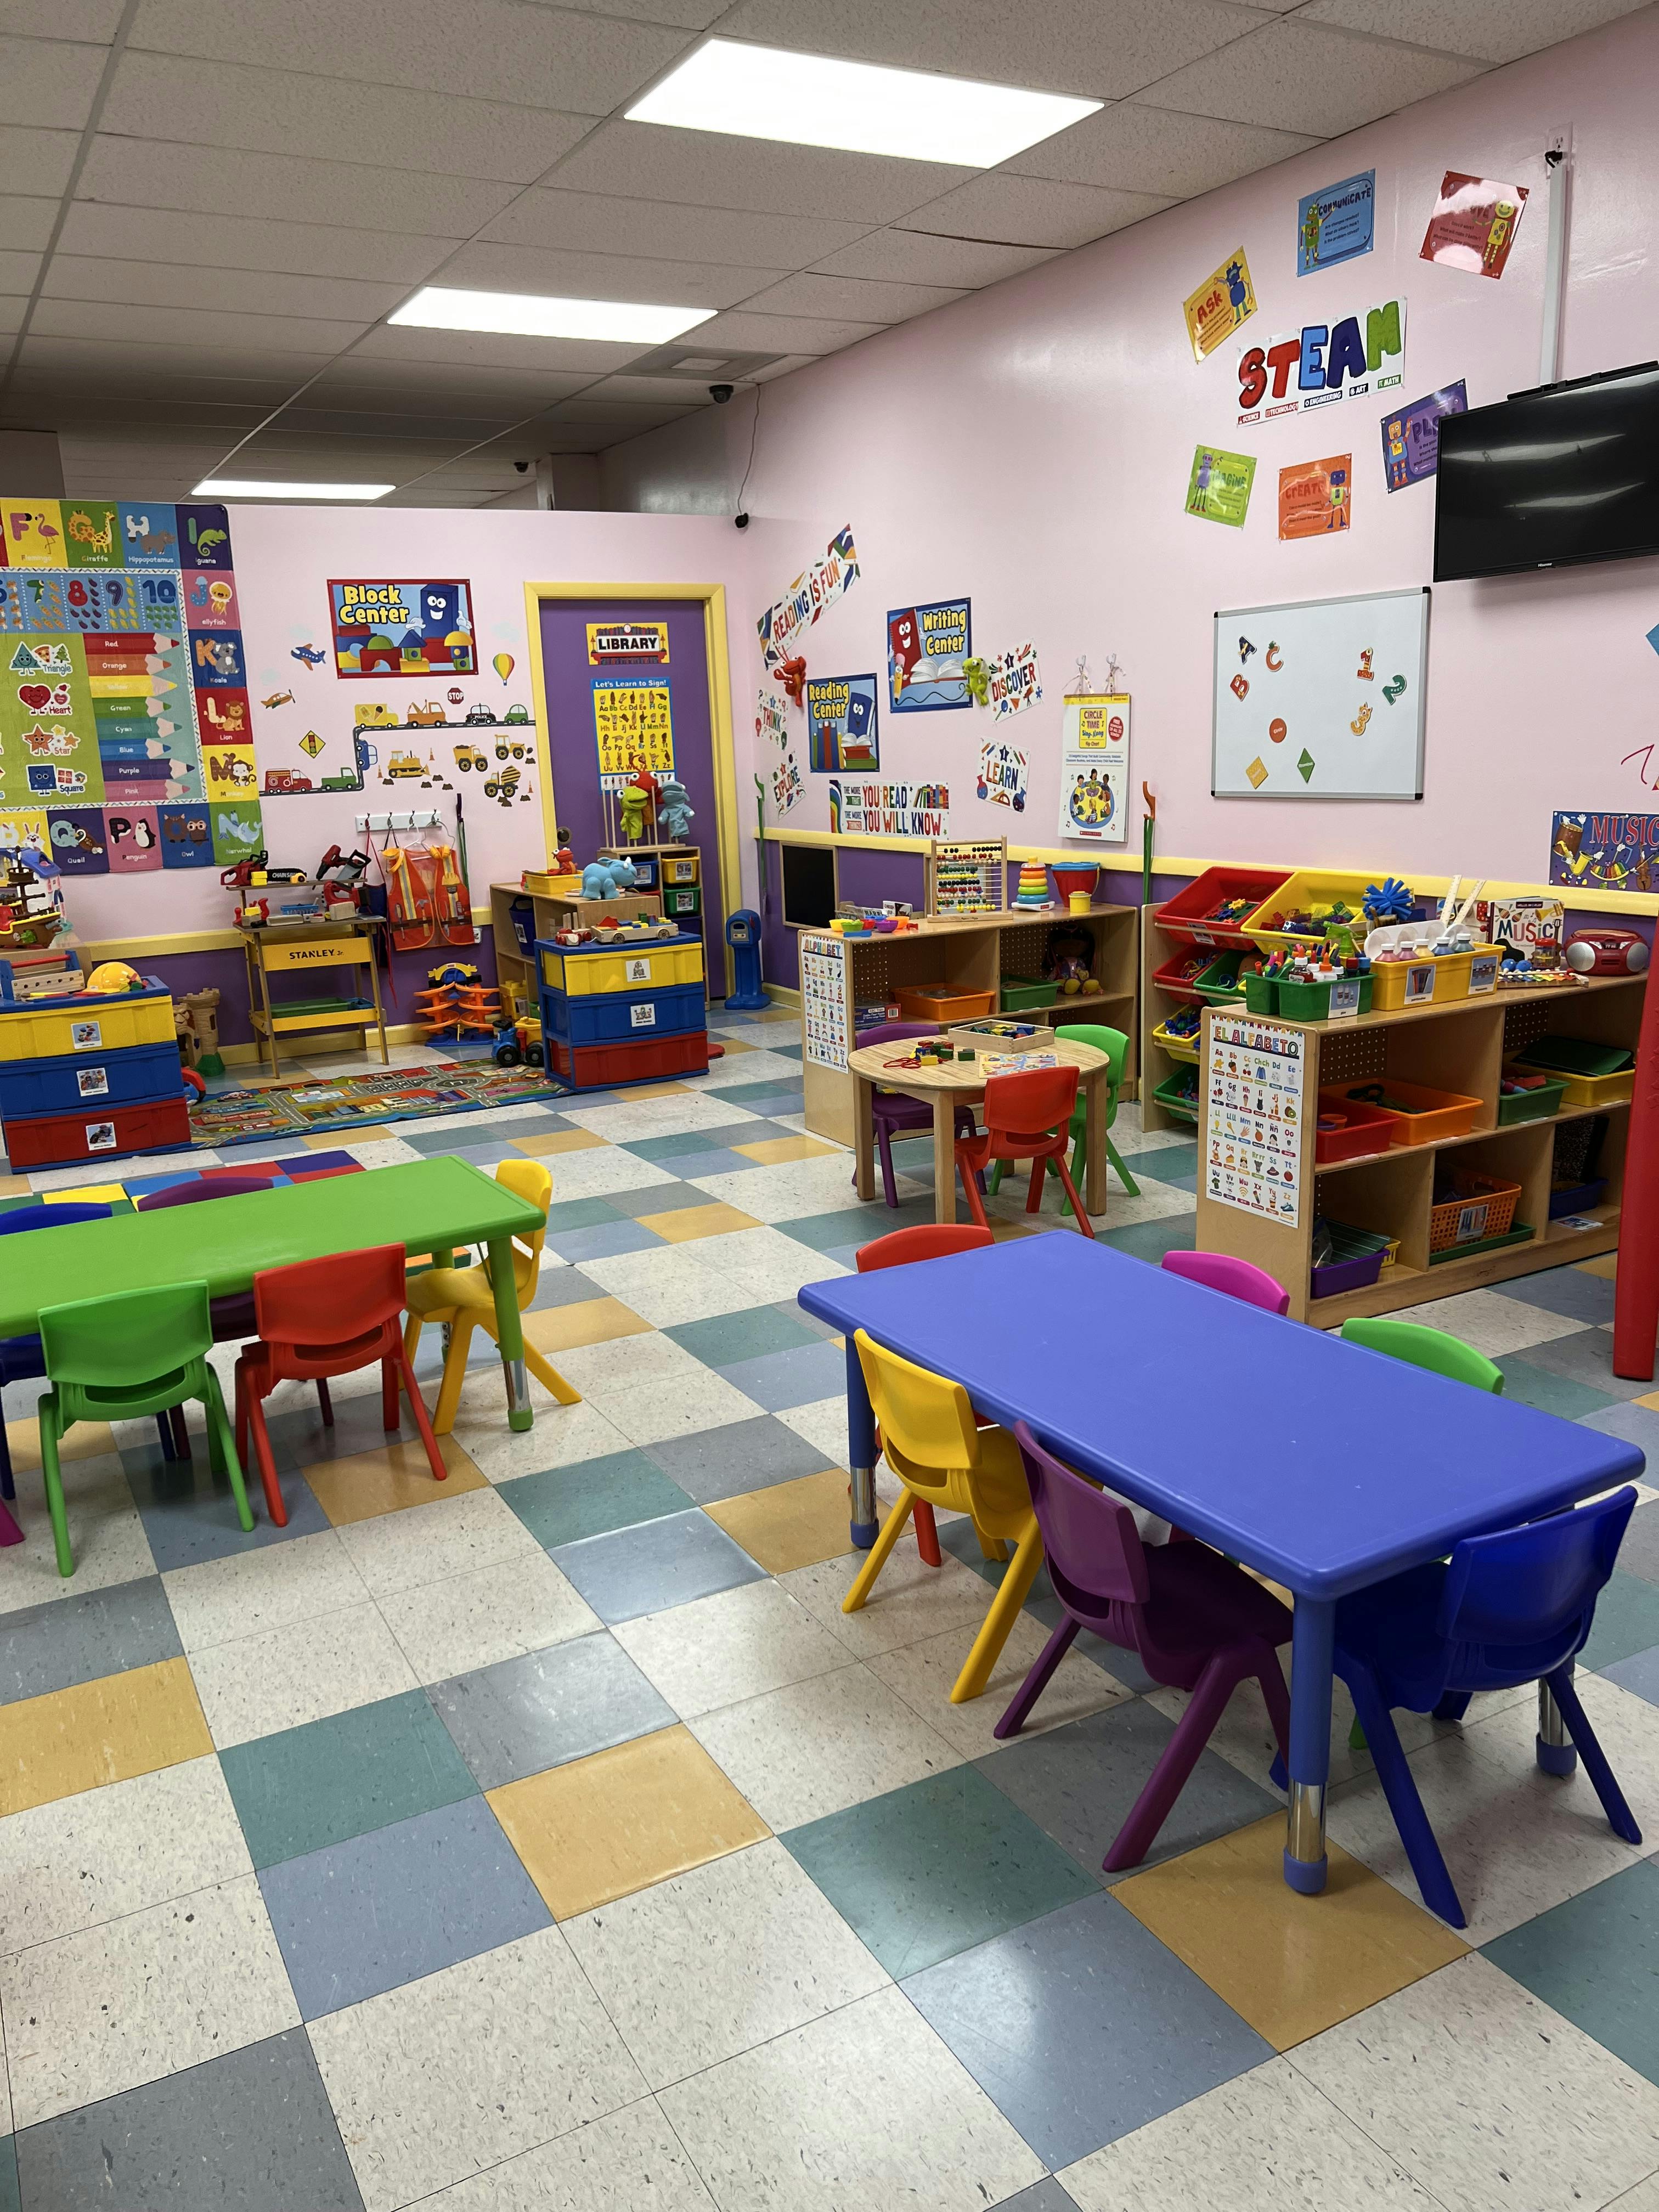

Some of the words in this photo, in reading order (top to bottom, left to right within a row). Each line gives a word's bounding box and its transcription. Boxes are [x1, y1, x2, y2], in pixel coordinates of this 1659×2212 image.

[1239, 301, 1402, 409] STEAM
[1269, 402, 1299, 416] TECHNOLOGY
[1309, 391, 1342, 405] ENGINEERING
[1356, 385, 1367, 394] ART
[1384, 375, 1400, 386] MATH
[10, 512, 32, 541] F
[68, 510, 97, 543] G
[82, 554, 109, 562] Giraffe
[128, 556, 174, 565] Hippopotamus
[195, 557, 217, 566] Iguana
[27, 579, 44, 604] 7
[67, 580, 88, 607] 8
[106, 580, 123, 607] 9
[142, 579, 177, 604] 10
[343, 584, 403, 606] Block
[773, 589, 810, 644] READING
[809, 578, 821, 606] IS
[820, 556, 840, 595] FUN
[338, 605, 411, 625] Center
[922, 608, 967, 633] Writing
[195, 638, 218, 667] K
[598, 637, 658, 651] LIBRARY
[925, 634, 965, 656] Center
[1238, 636, 1256, 664] A
[102, 662, 127, 670] Orange
[1266, 645, 1283, 672] C
[42, 664, 72, 676] Triangle
[808, 680, 850, 705] Reading
[991, 662, 1037, 702] DISCOVER
[1230, 674, 1249, 702] B
[448, 692, 465, 701] STOP
[658, 703, 667, 712] Gg
[49, 706, 71, 715] Heart
[206, 697, 227, 724] L
[763, 706, 782, 733] THINK
[813, 702, 847, 720] Center
[1084, 710, 1102, 719] CIRCLE
[1087, 720, 1099, 729] TIME
[54, 746, 71, 755] Star
[614, 744, 623, 752] Pp
[625, 743, 636, 752] Qq
[119, 768, 140, 776] Purple
[986, 760, 1019, 791] LEARN
[59, 784, 84, 795] Square
[773, 765, 802, 803] EXPLORE
[851, 786, 861, 794] MORE
[862, 785, 879, 808] YOU
[882, 785, 907, 809] READ
[109, 817, 132, 844] P
[218, 810, 241, 840] N
[864, 810, 880, 832] YOU
[883, 811, 909, 833] WILL
[911, 811, 942, 836] KNOW
[1589, 815, 1659, 847] MUSIC
[122, 854, 147, 862] Penguin
[289, 949, 335, 960] STANLEY
[804, 939, 841, 957] ALPHABET
[1215, 1025, 1229, 1042] EL
[1232, 1029, 1299, 1056] ALFABETO
[1215, 1048, 1223, 1057] Aa
[1254, 1058, 1269, 1067] Chch
[1228, 1082, 1237, 1092] Gg
[1243, 1086, 1250, 1094] Hh
[1272, 1093, 1278, 1103] Jj
[1286, 1097, 1295, 1105] Kk
[1240, 1116, 1251, 1125] Mm
[1255, 1121, 1264, 1129] Nn
[1269, 1123, 1278, 1133] Ññ
[1284, 1129, 1294, 1137] Oo
[1212, 1139, 1220, 1150] Pp
[1226, 1144, 1234, 1153] Qq
[1269, 1156, 1277, 1165] Ss
[1284, 1161, 1293, 1169] Tt
[1212, 1169, 1220, 1177] Uu
[1239, 1177, 1249, 1186] Ww
[1254, 1182, 1262, 1190] Xx
[1283, 1192, 1291, 1200] Zz
